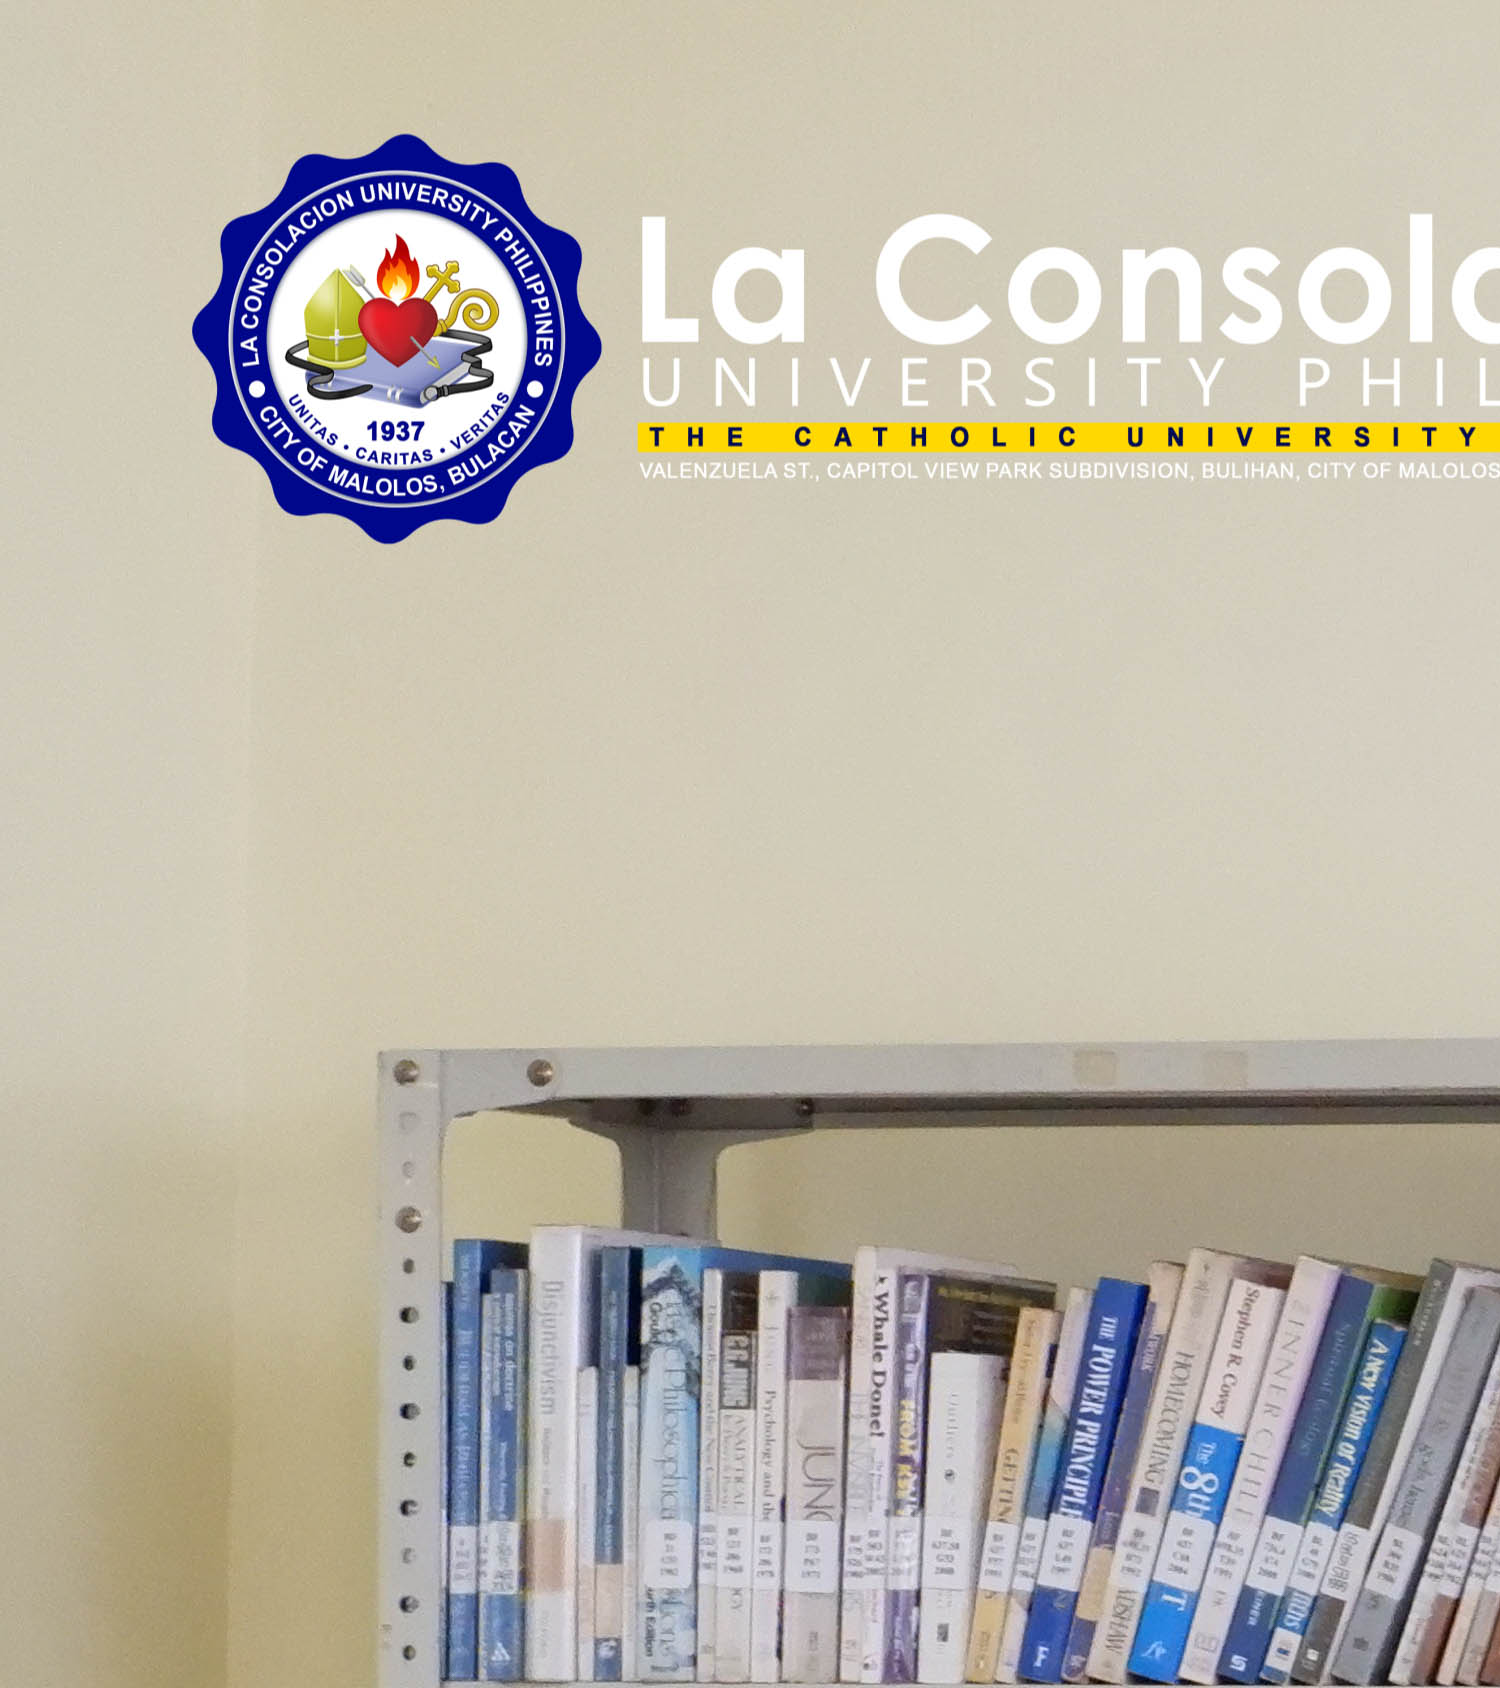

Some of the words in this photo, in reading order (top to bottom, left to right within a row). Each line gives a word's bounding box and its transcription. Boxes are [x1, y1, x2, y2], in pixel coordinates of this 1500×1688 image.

[870, 1290, 890, 1363] Whale
[1100, 1315, 1118, 1341] THE
[1229, 1285, 1262, 1352] Stephen
[869, 1369, 886, 1438] Done!
[1080, 1343, 1117, 1414] POWER
[1208, 1371, 1238, 1421] Covey
[1144, 1350, 1195, 1485] HOMECOMING
